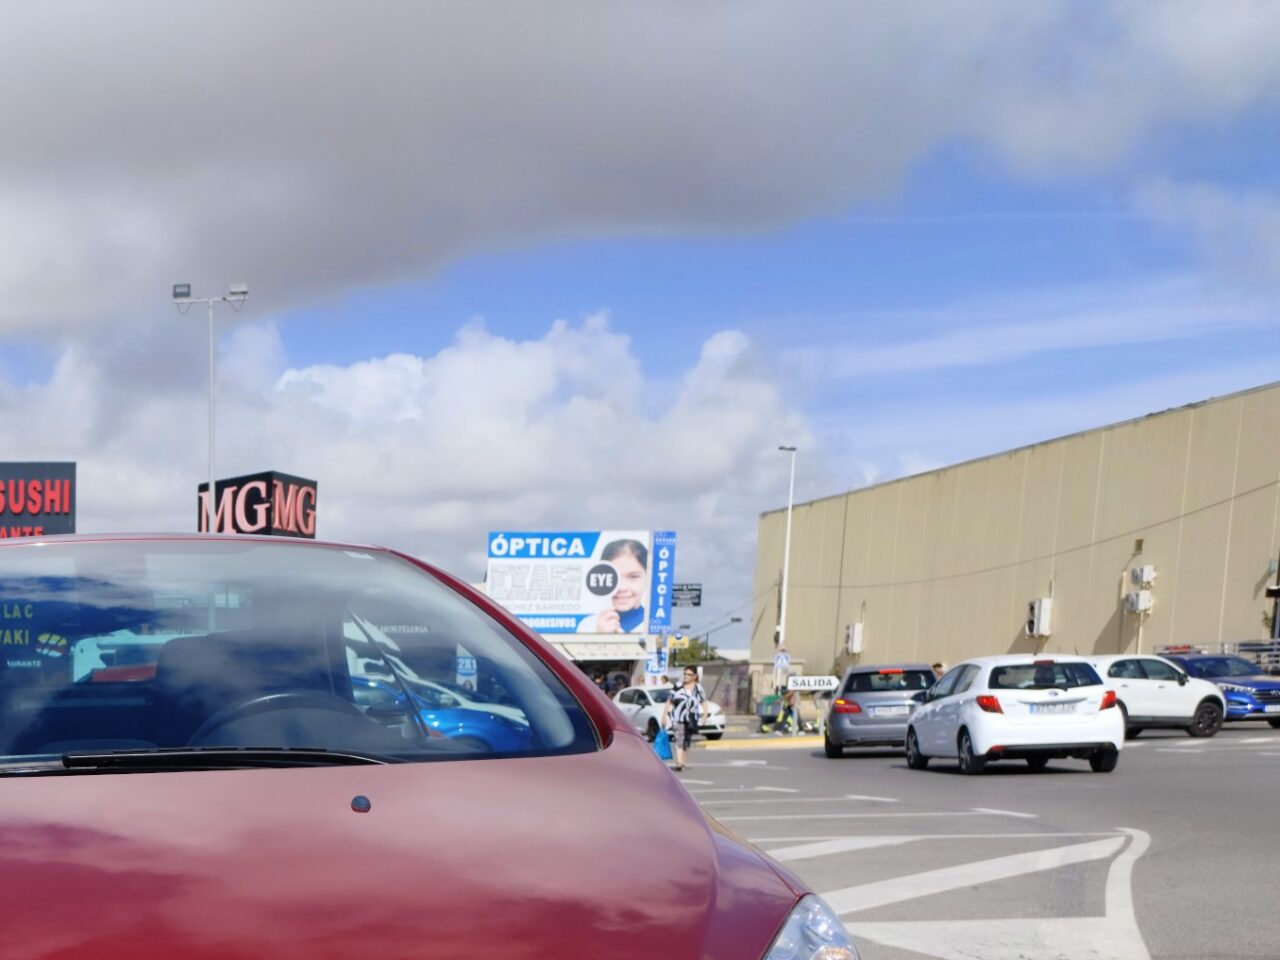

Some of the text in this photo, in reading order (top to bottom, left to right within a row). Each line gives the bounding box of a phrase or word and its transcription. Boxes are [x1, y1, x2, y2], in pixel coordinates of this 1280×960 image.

[198, 480, 270, 535] MG
[272, 479, 316, 535] MG
[490, 534, 586, 556] ÓPTICA
[589, 573, 613, 587] EYE
[4, 604, 22, 618] LA
[791, 679, 834, 689] SALIDA
